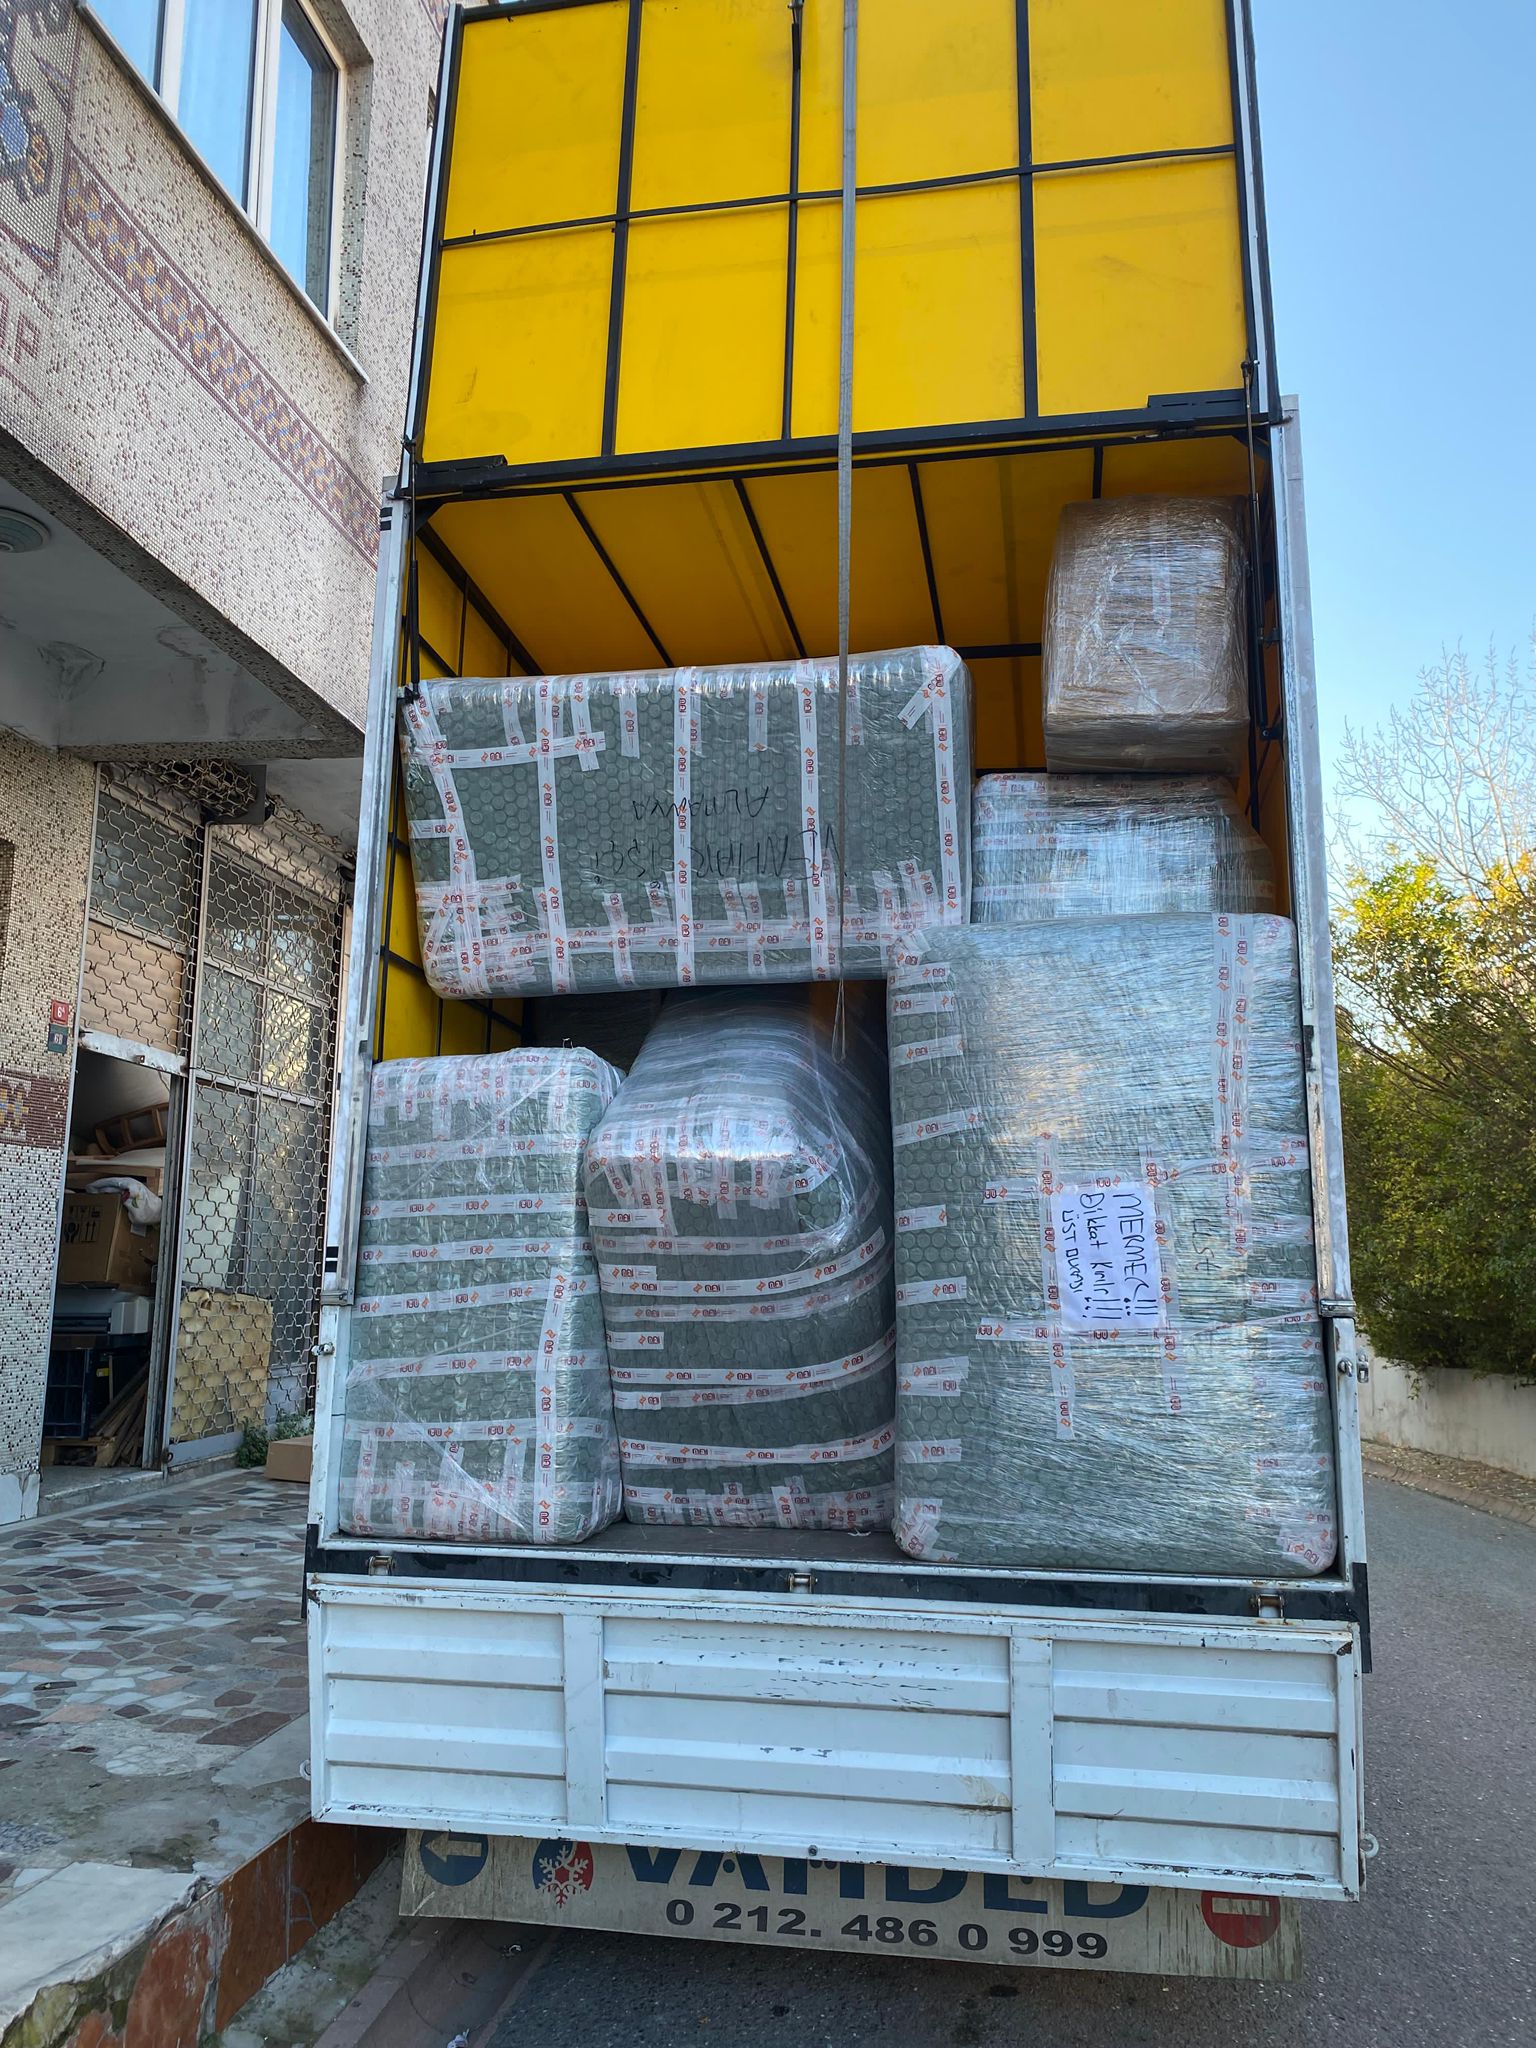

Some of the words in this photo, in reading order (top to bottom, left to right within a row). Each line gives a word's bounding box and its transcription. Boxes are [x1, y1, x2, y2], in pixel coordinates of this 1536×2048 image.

[666, 1899, 695, 1926] 0
[712, 1902, 822, 1938] 212.
[841, 1914, 938, 1947] 486
[958, 1923, 988, 1951] 0
[1008, 1927, 1108, 1960] 999
